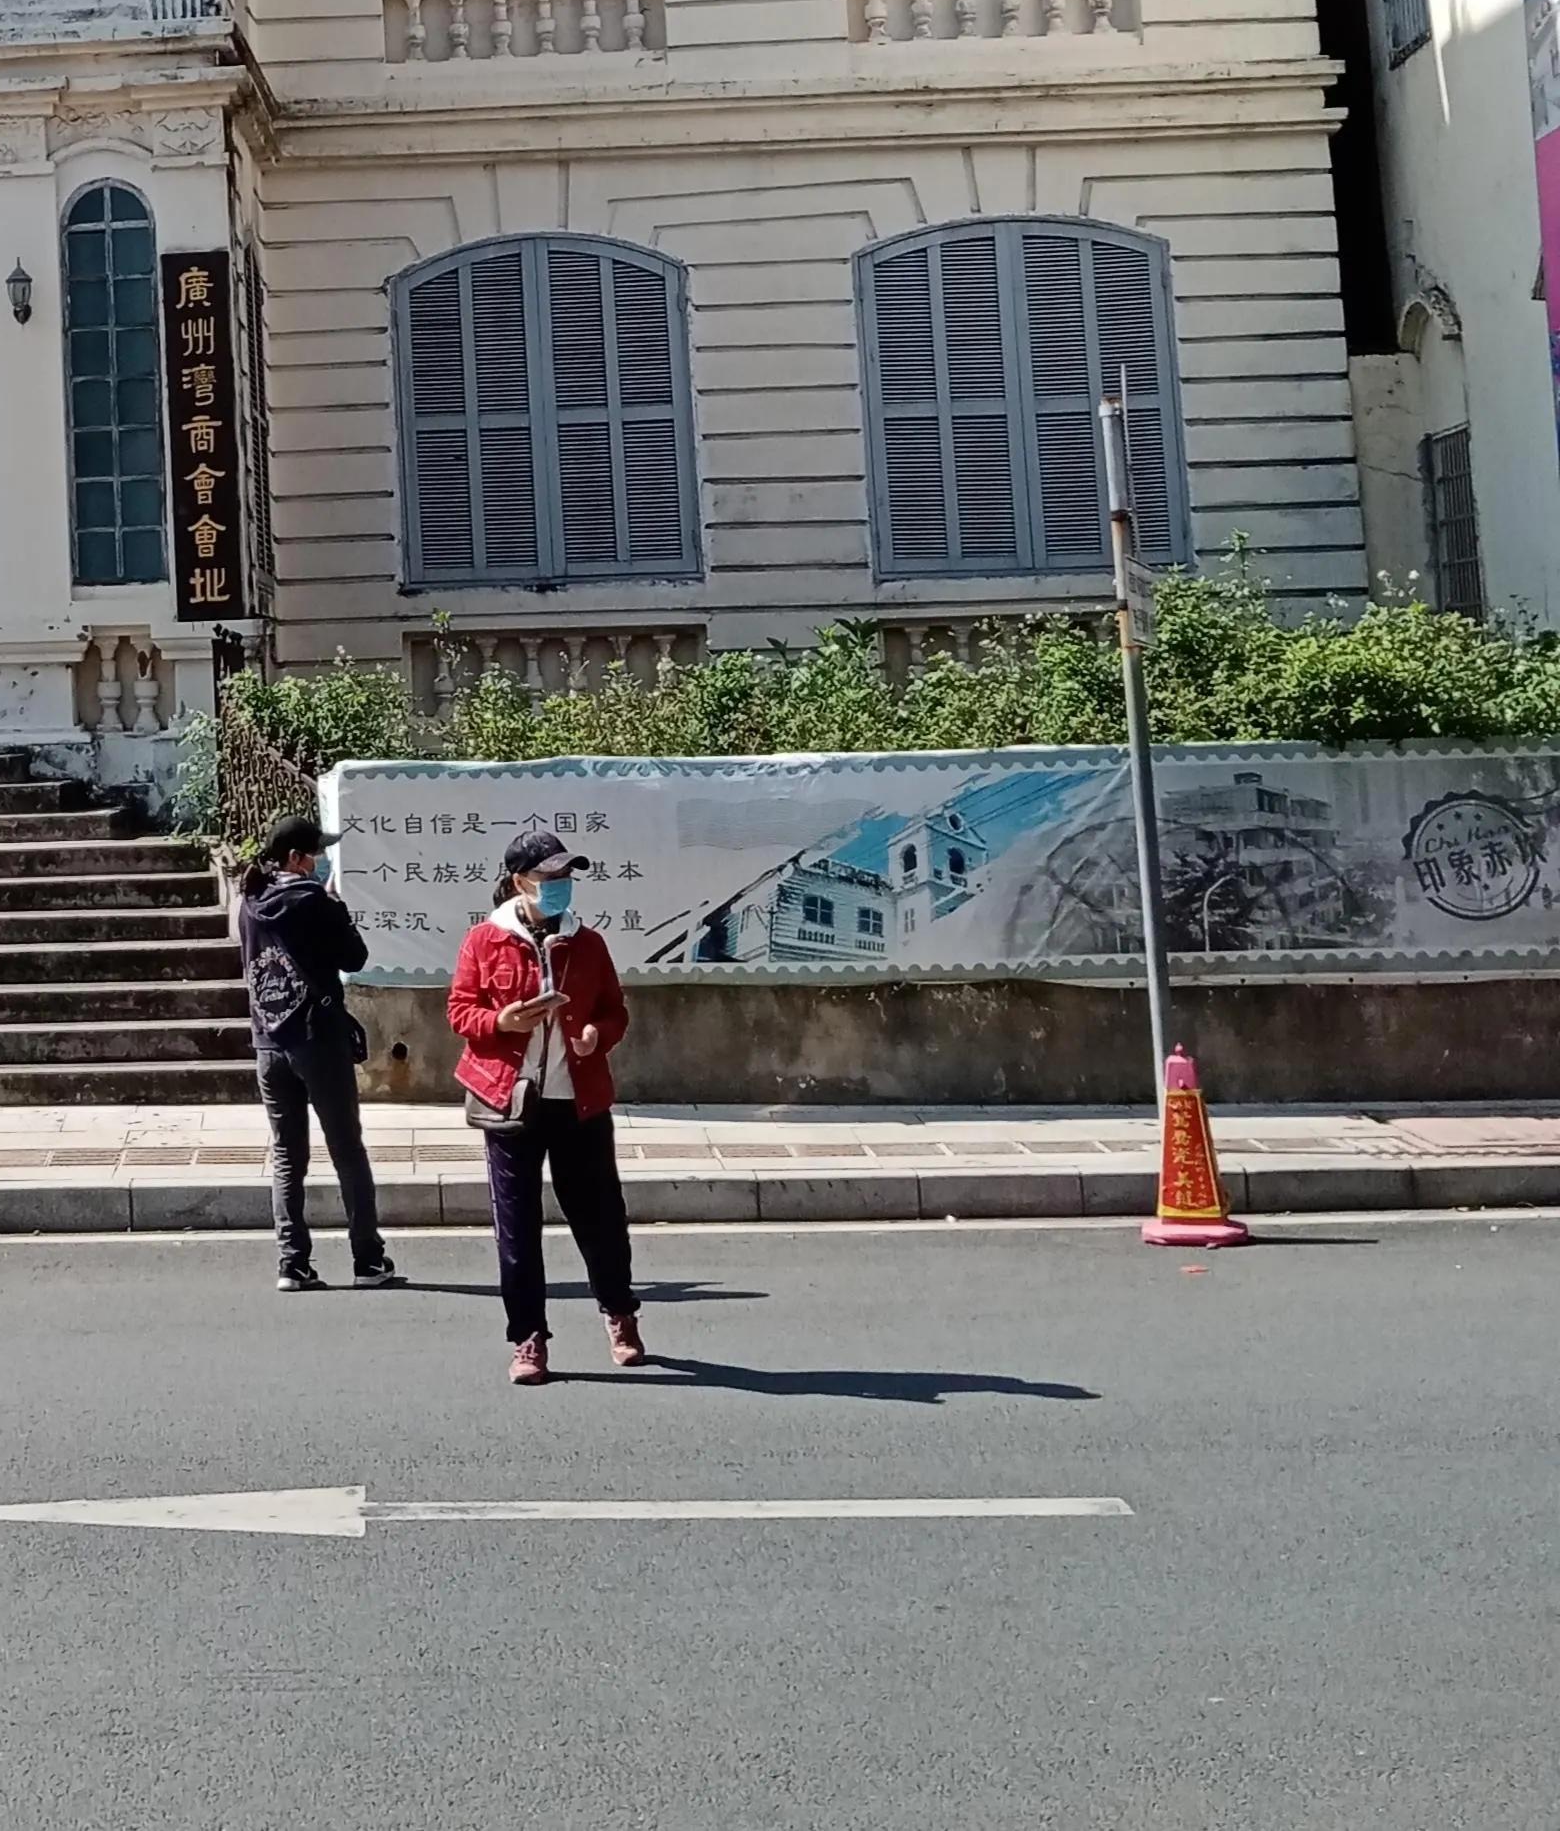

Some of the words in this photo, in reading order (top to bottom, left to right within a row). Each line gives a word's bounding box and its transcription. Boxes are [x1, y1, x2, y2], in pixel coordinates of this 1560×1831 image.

[175, 265, 231, 605] 廣州灣商會會址
[342, 811, 611, 835] 文化自信是一个国家
[1412, 833, 1548, 893] 印象赤坎
